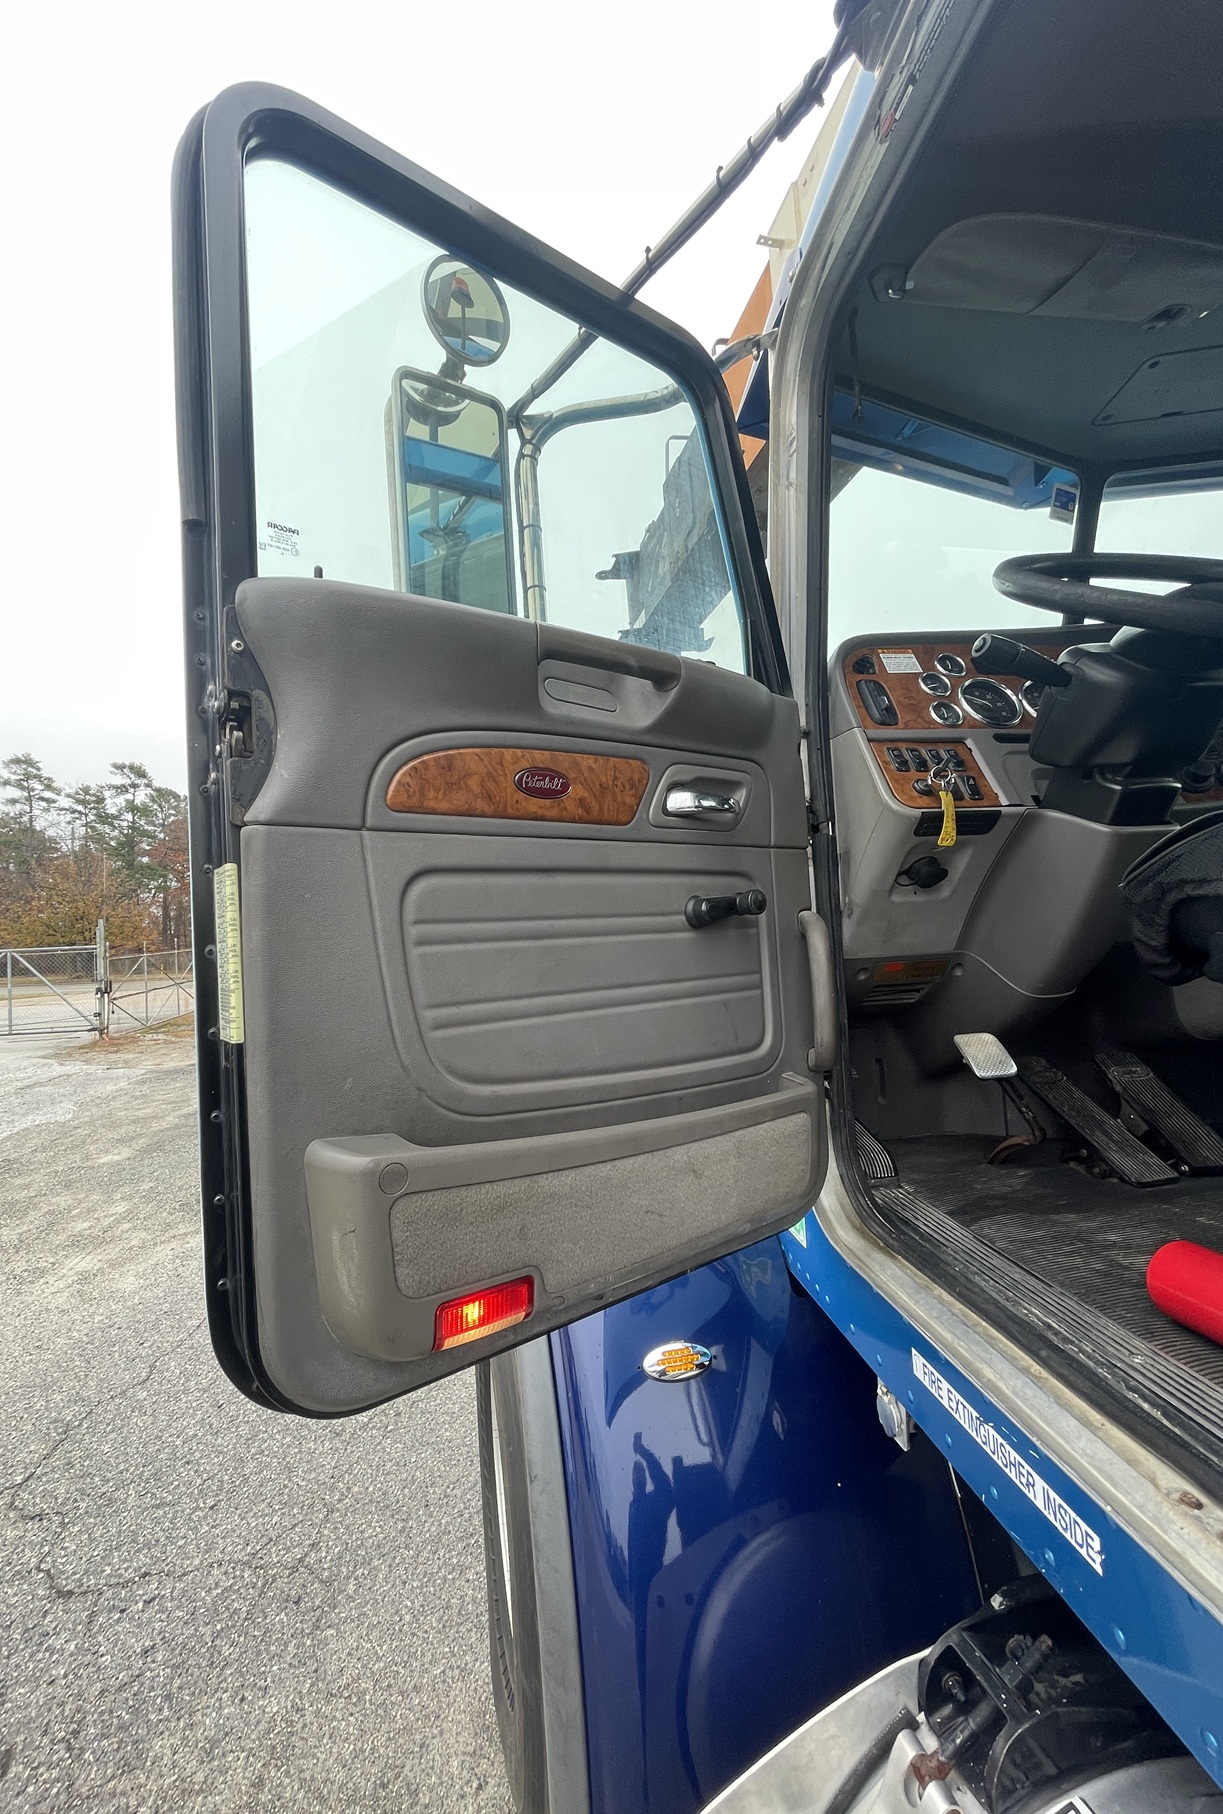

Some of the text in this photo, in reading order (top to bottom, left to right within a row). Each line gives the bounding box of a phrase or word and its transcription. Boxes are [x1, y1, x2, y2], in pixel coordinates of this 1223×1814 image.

[522, 772, 566, 790] Peterbilt
[922, 1363, 1100, 1564] FIRE EXTINGUISHER INSIDE
